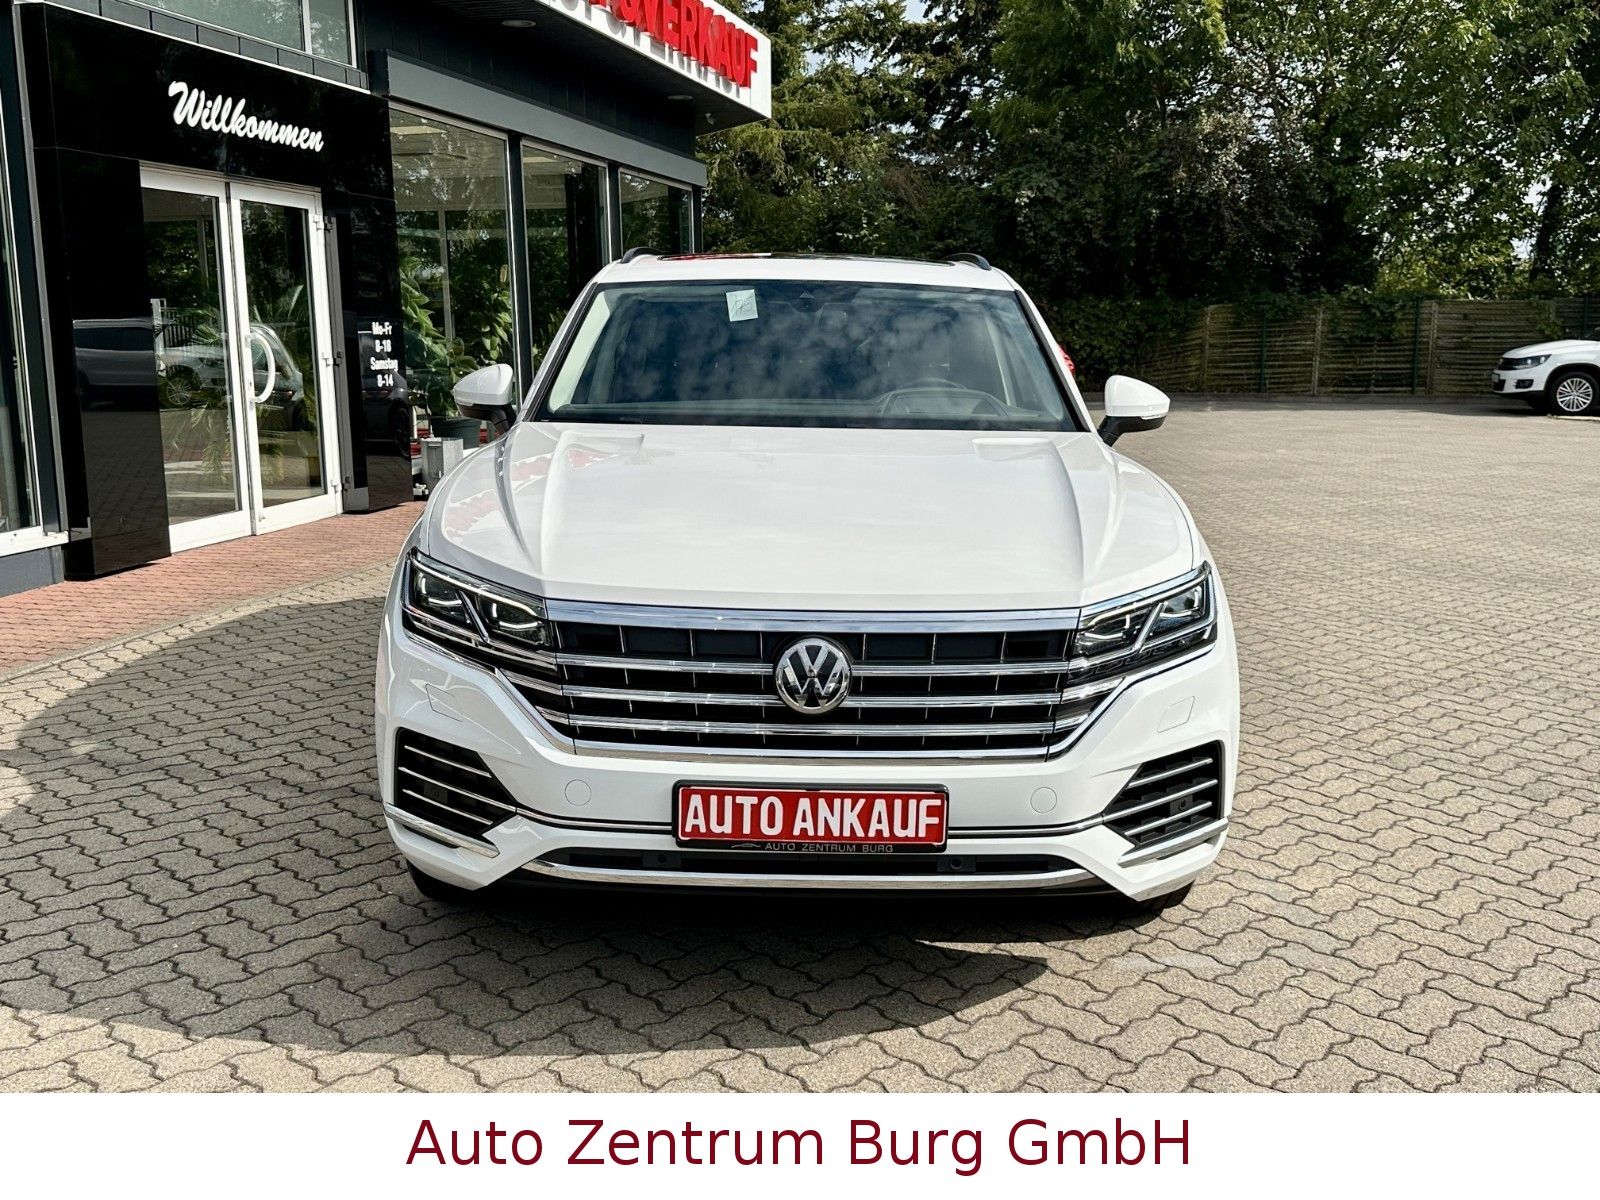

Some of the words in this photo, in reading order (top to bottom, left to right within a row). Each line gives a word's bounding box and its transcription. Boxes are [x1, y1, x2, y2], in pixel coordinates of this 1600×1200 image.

[588, 0, 758, 88] VERKAUF
[168, 81, 324, 152] Willkommen
[371, 321, 393, 335] Mo-Fr
[374, 339, 392, 352] 8-18
[370, 356, 399, 372] Samstag
[376, 373, 394, 388] 8-14
[776, 637, 852, 714] VW
[684, 794, 784, 836] AUTO
[792, 797, 942, 838] ANKAUF
[764, 842, 796, 852] AUTO
[801, 843, 857, 853] ZENTRUM
[862, 844, 894, 853] BURG
